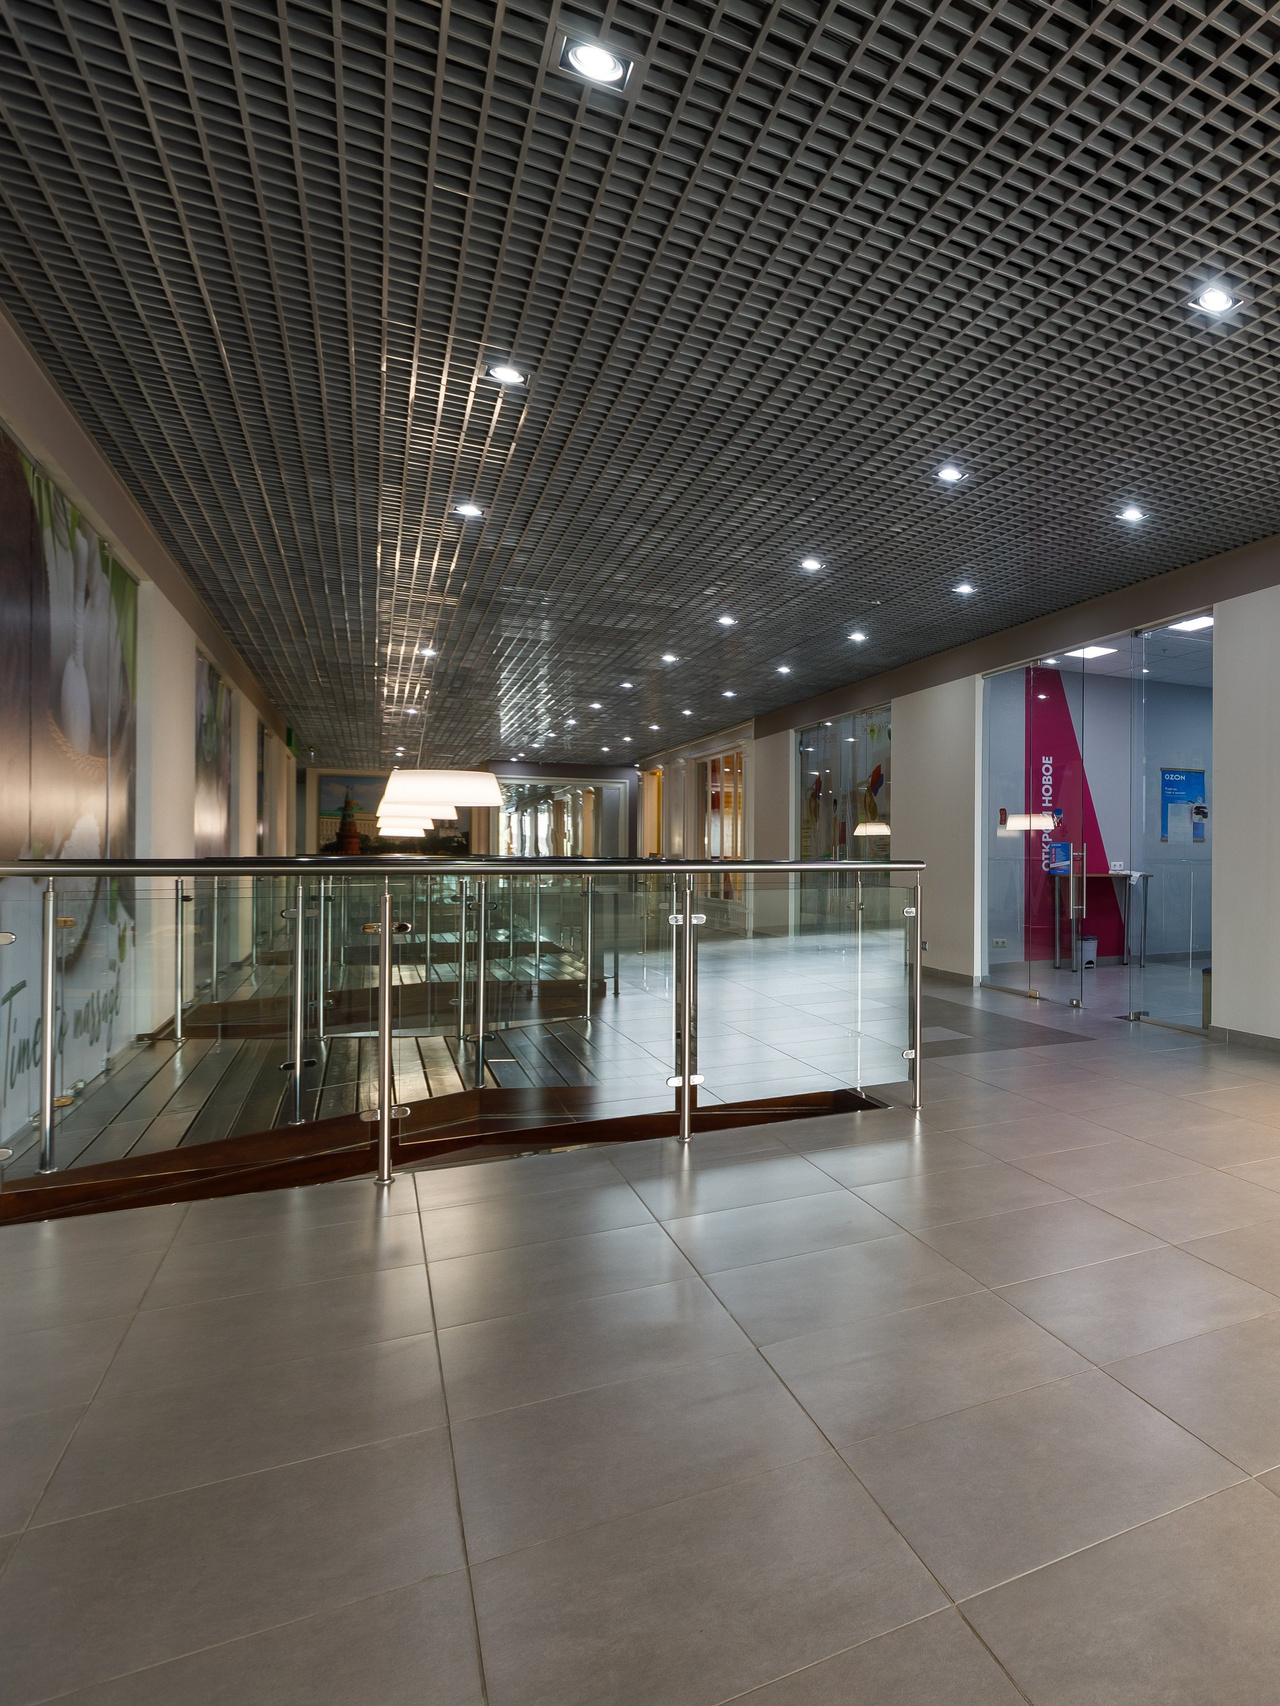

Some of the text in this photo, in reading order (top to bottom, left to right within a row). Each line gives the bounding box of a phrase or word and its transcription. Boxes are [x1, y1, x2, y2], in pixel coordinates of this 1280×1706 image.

[1164, 773, 1186, 781] OZON
[1041, 756, 1053, 872] ОТКРЙ НОВОЕ
